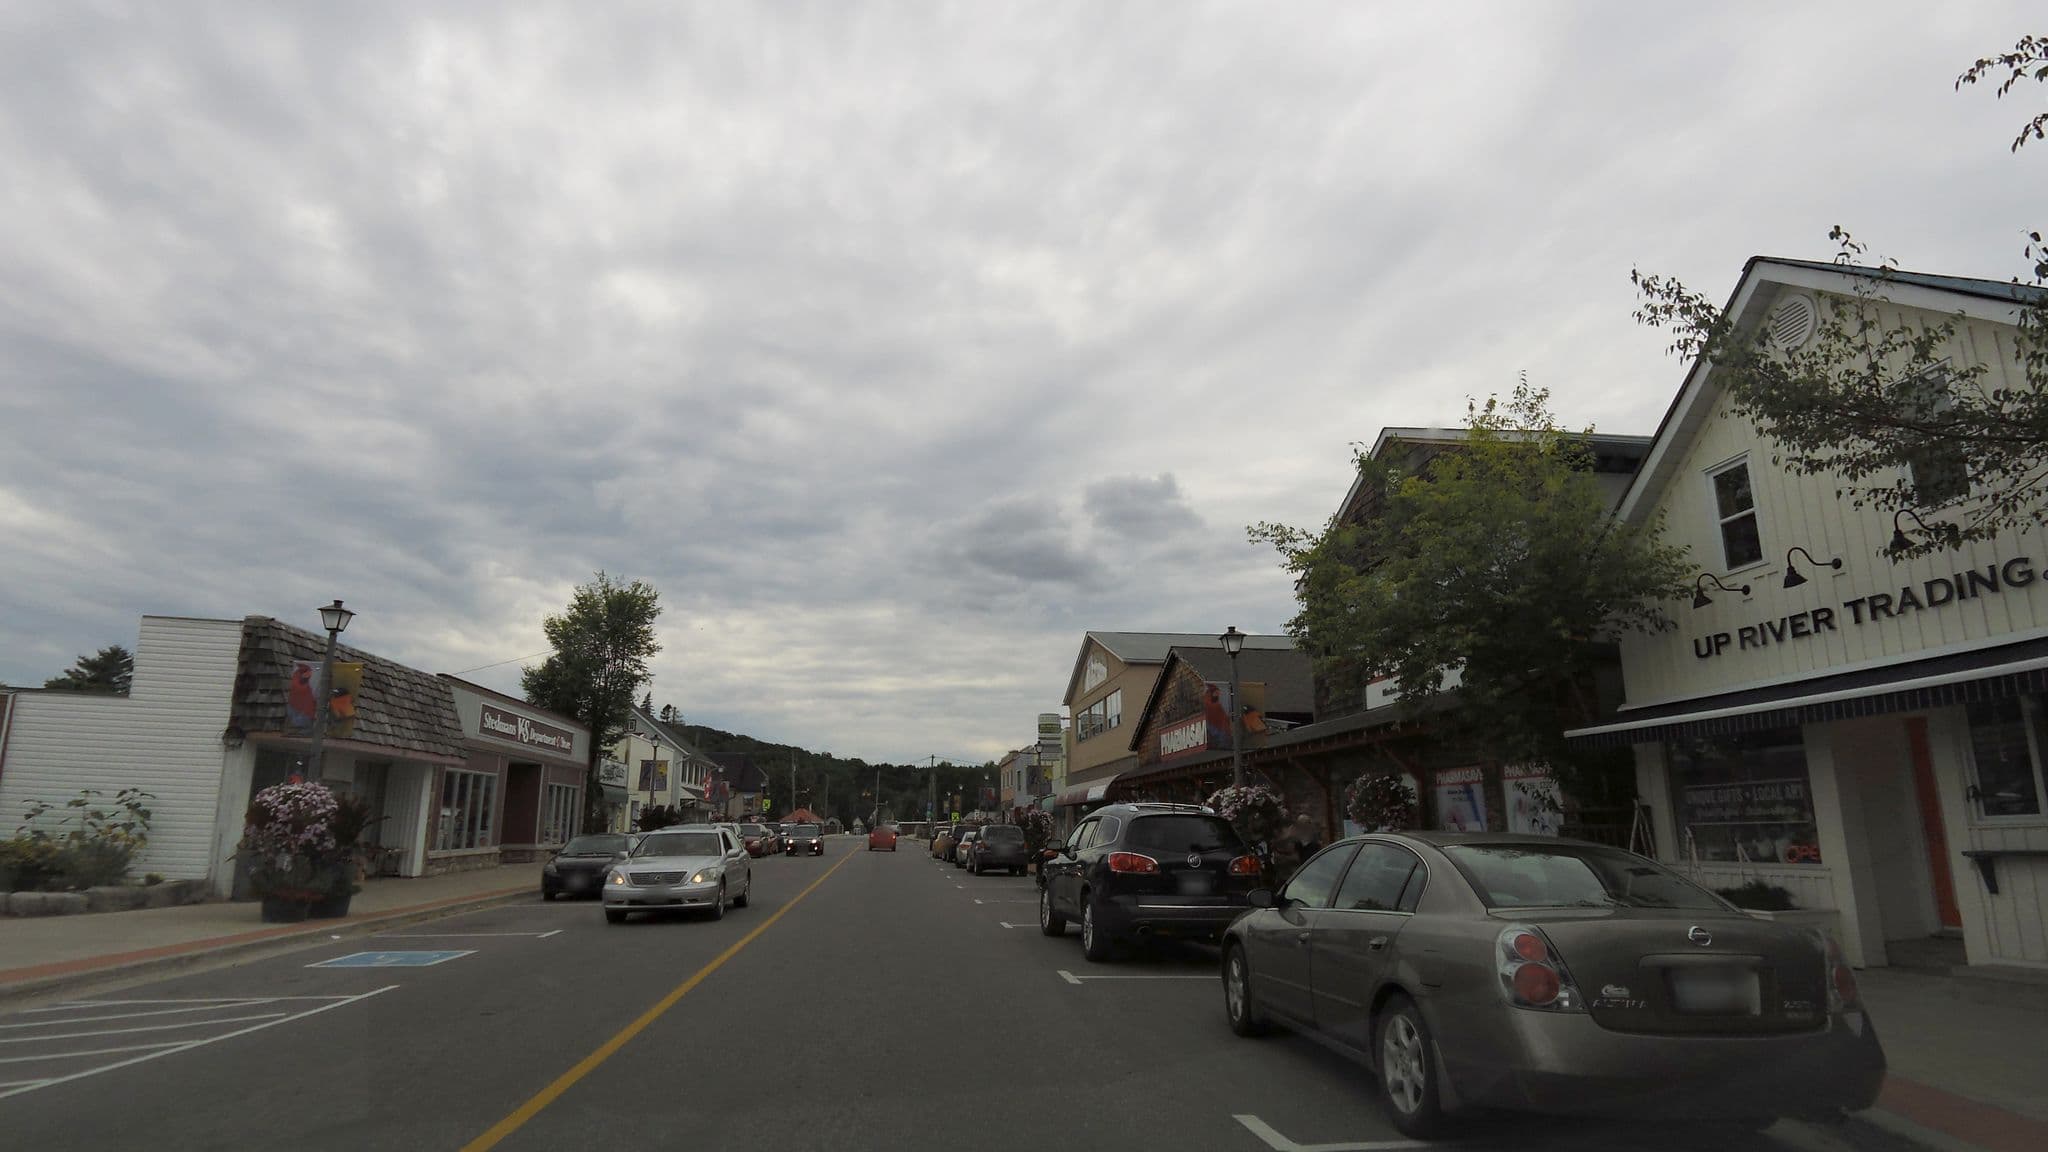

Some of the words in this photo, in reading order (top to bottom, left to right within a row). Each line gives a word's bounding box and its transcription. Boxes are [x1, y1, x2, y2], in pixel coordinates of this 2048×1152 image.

[1694, 632, 1731, 659] UP
[1738, 607, 1837, 650] RIVER
[1844, 557, 2036, 625] TRADING
[483, 712, 517, 736] Stedmans
[1717, 786, 1744, 801] GIFTS
[1752, 784, 1783, 801] LOCAL
